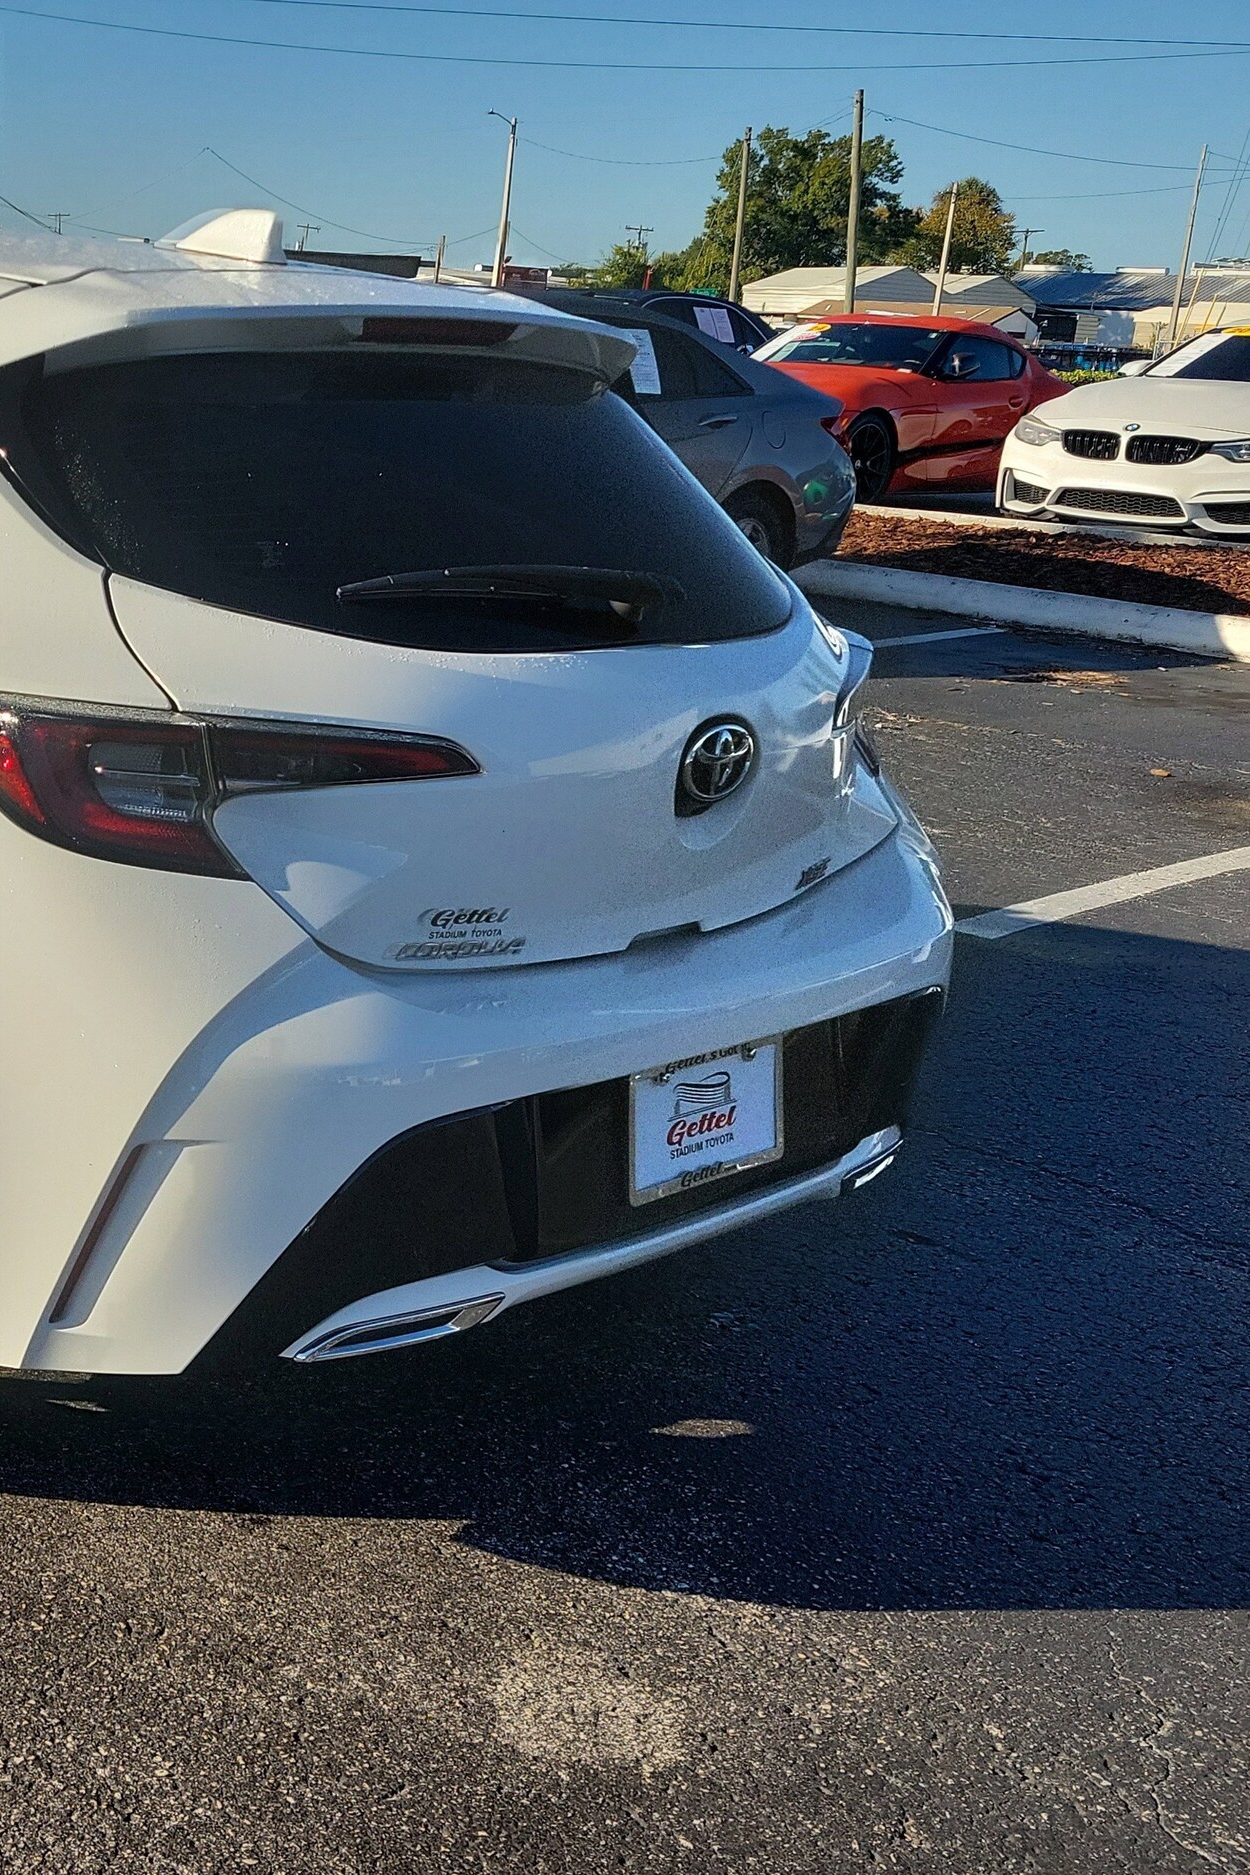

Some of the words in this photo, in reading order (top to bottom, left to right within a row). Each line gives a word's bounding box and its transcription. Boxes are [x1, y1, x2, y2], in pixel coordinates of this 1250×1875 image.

[430, 907, 511, 929] Gettel
[428, 930, 467, 940] STADIUM
[471, 928, 502, 938] TOYOTA
[667, 1105, 737, 1147] Gettel
[670, 1142, 703, 1160] STADIUM
[704, 1132, 735, 1148] TOYOTA
[680, 1161, 724, 1188] Gettel
